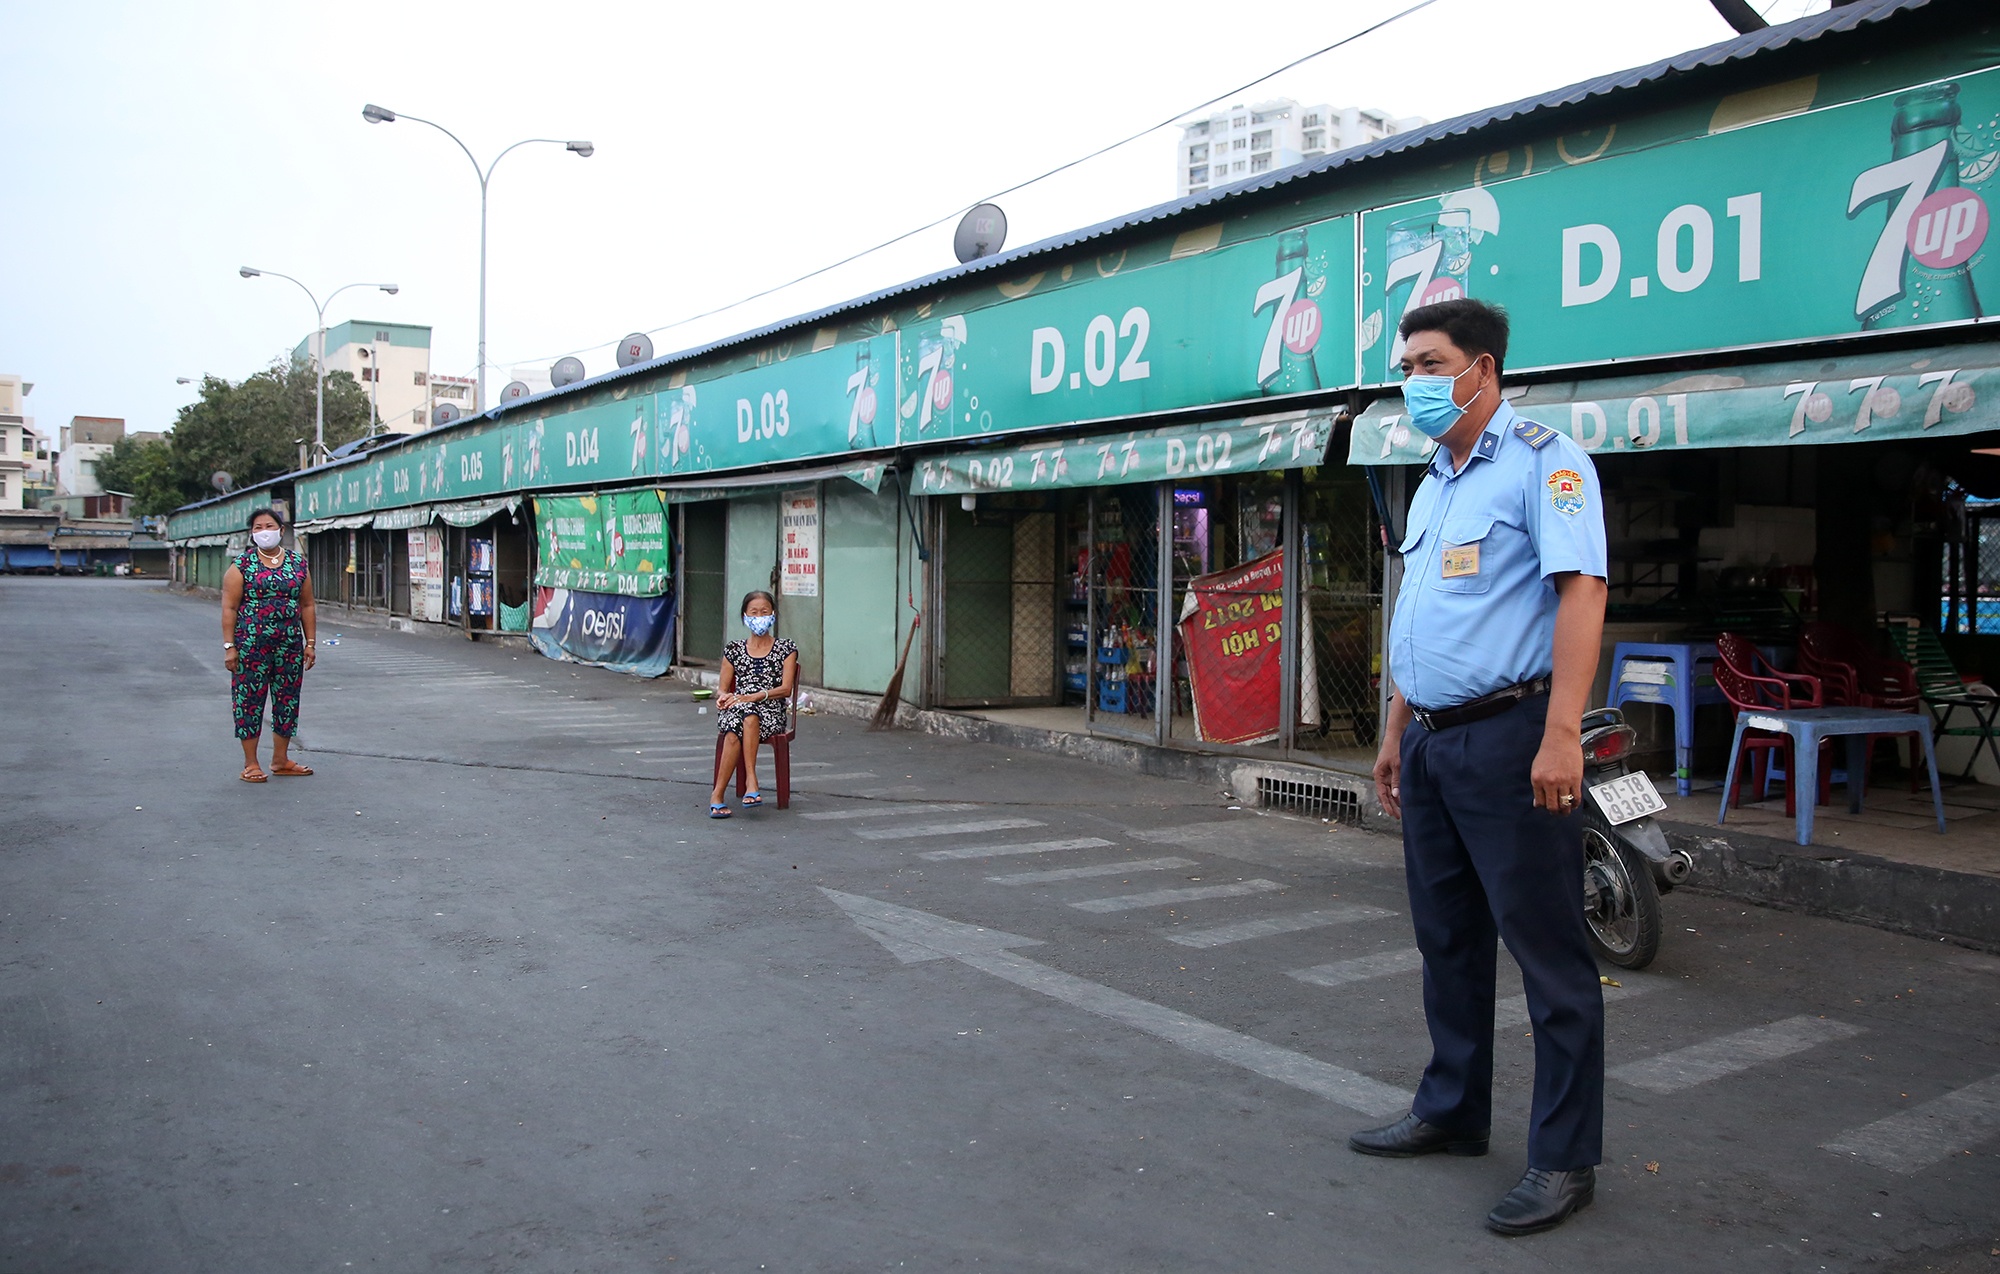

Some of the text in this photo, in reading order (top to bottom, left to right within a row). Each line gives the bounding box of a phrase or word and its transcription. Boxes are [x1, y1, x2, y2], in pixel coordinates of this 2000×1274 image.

[1562, 191, 1762, 308] D.01
[1030, 306, 1150, 395] D.02
[736, 388, 790, 443] D.03
[1571, 394, 1689, 449] D.01
[461, 451, 483, 482] D.05
[566, 427, 599, 467] D.04
[969, 456, 1014, 490] D.02
[1166, 432, 1232, 475] D.02
[618, 574, 638, 595] D.04
[581, 605, 625, 646] pepsi
[1204, 598, 1255, 631] 2017
[1221, 628, 1261, 657] HỘI
[1600, 776, 1645, 803] 61-T8
[1611, 793, 1656, 820] 9369
